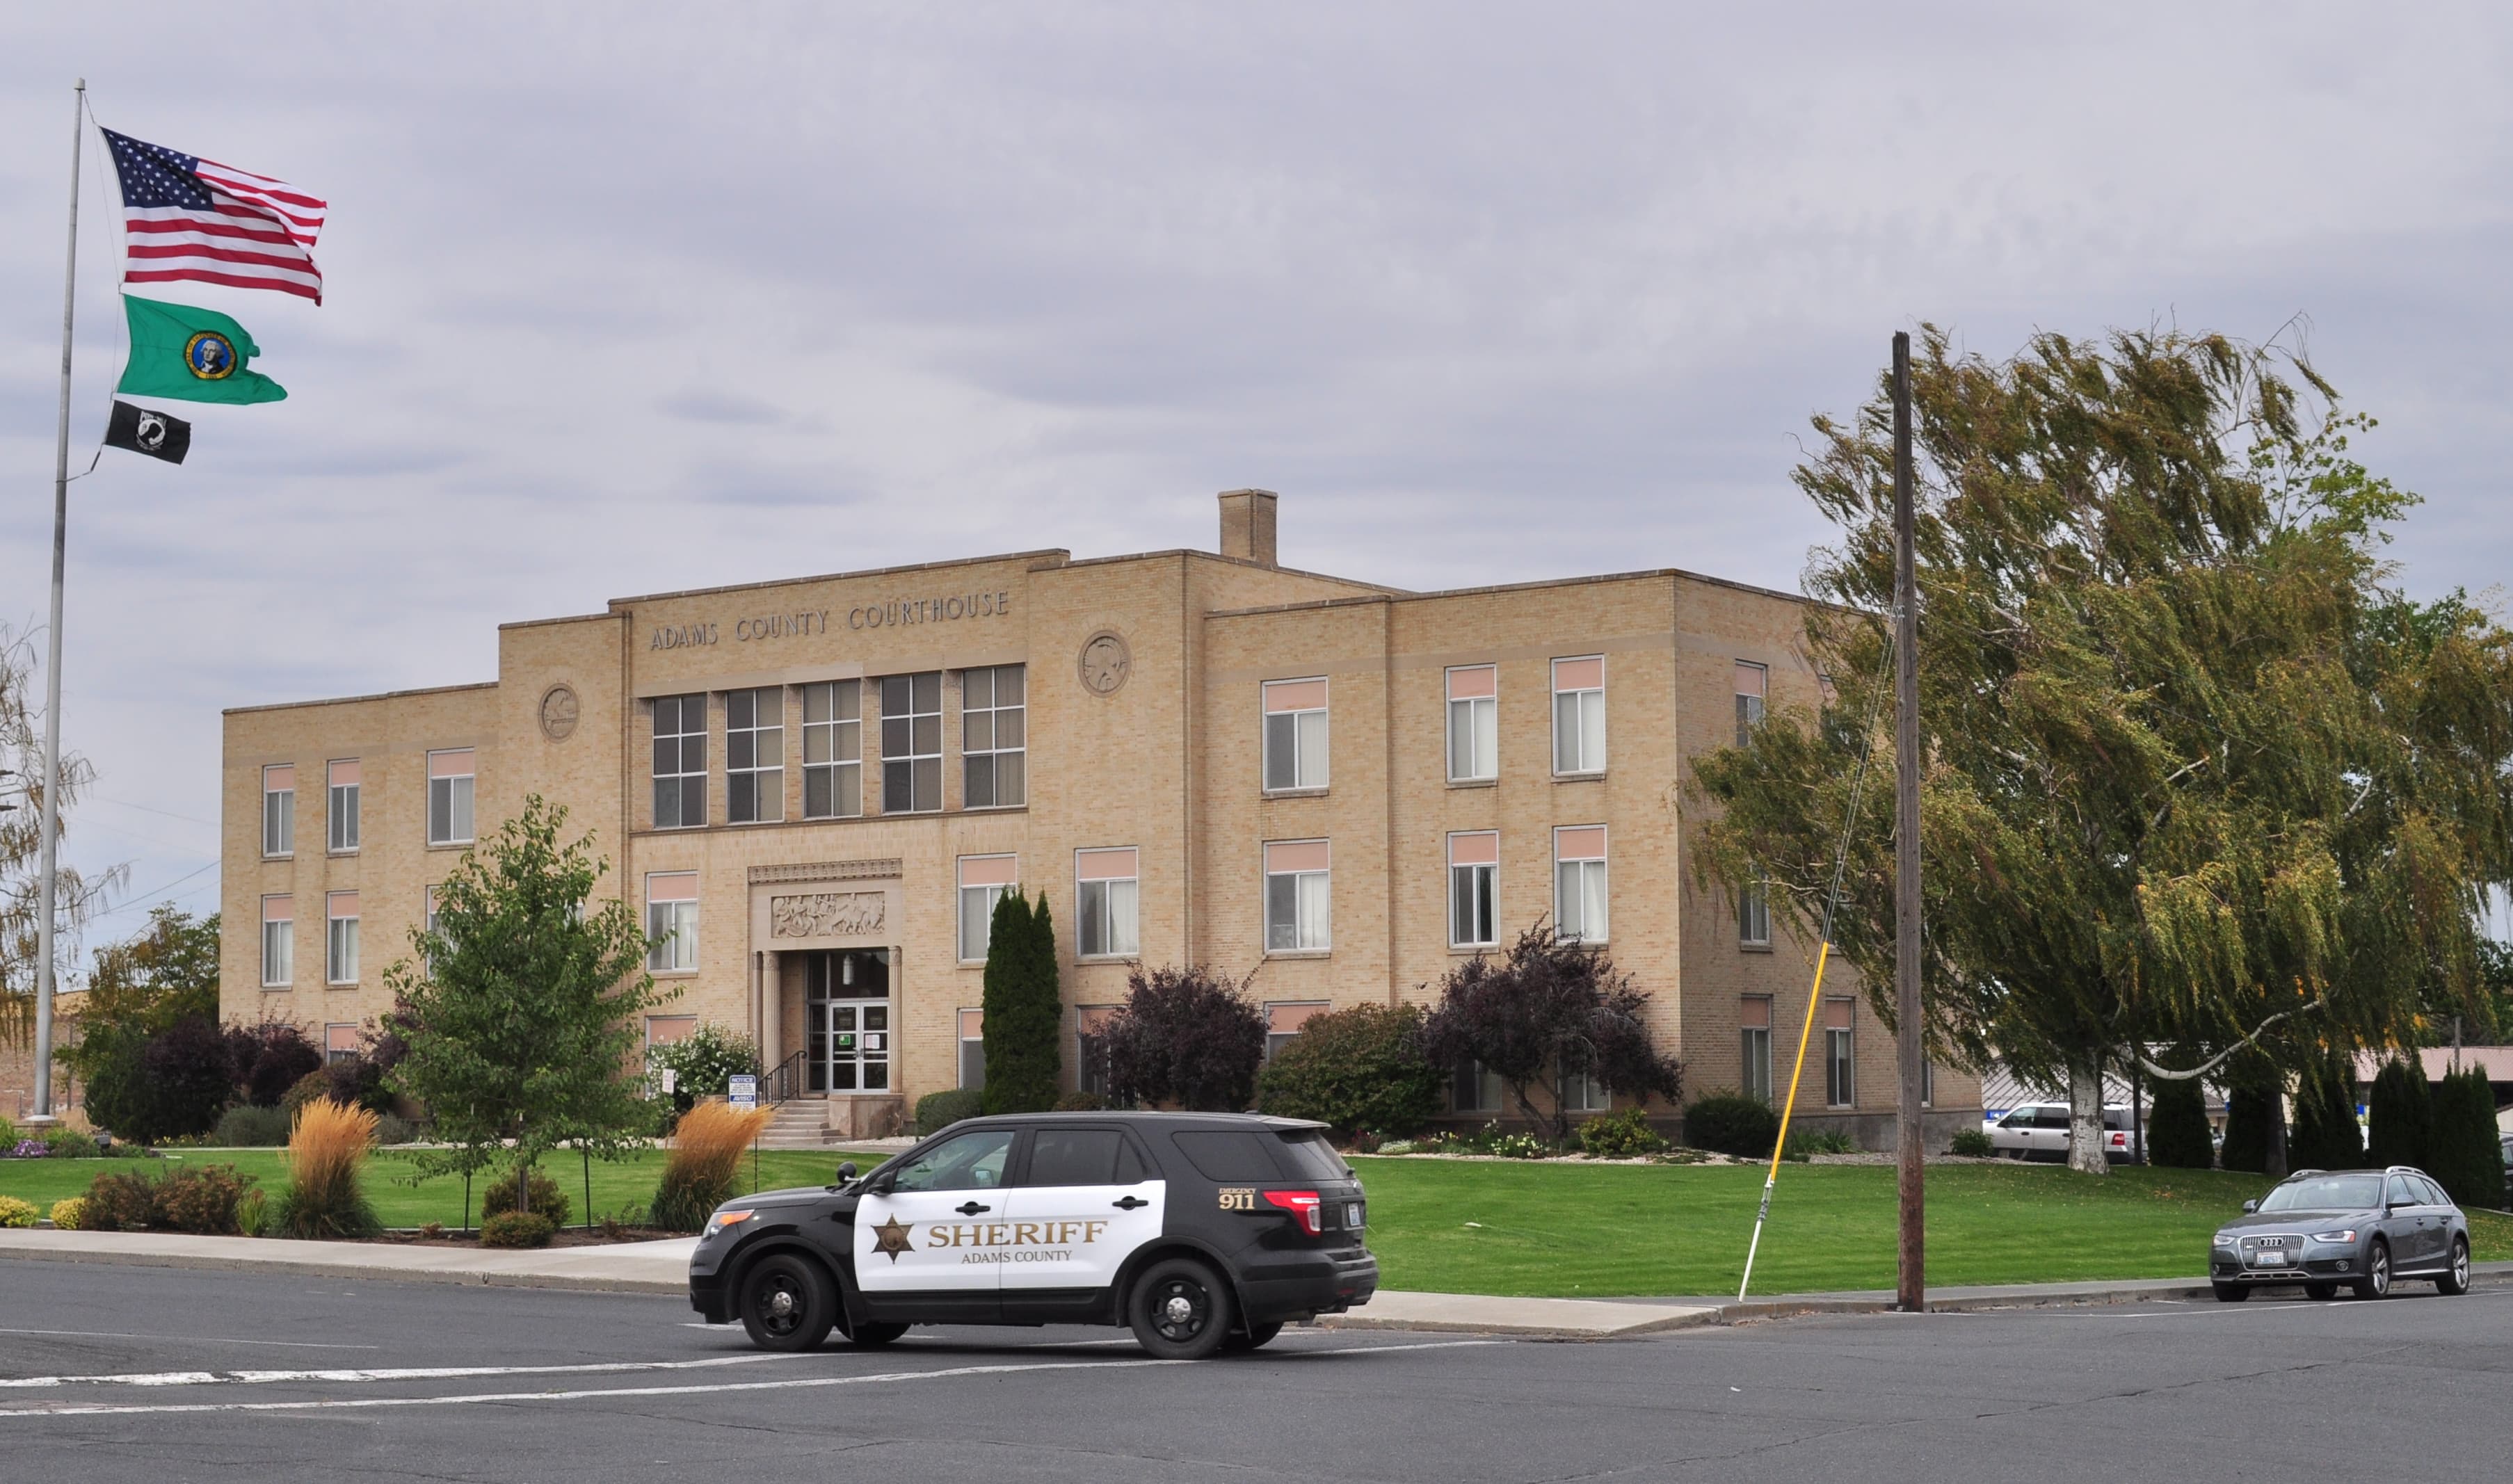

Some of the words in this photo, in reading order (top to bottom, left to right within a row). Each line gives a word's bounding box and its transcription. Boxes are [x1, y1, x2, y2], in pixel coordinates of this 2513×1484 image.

[651, 623, 718, 650] ADAMS
[735, 610, 829, 641] COUNTY
[848, 591, 1009, 629] COURTHOUSE
[1219, 1194, 1255, 1209] 911
[928, 1220, 1108, 1248] SHERIFF
[961, 1252, 1011, 1264] ADAMS
[1015, 1250, 1073, 1262] COUNTY
